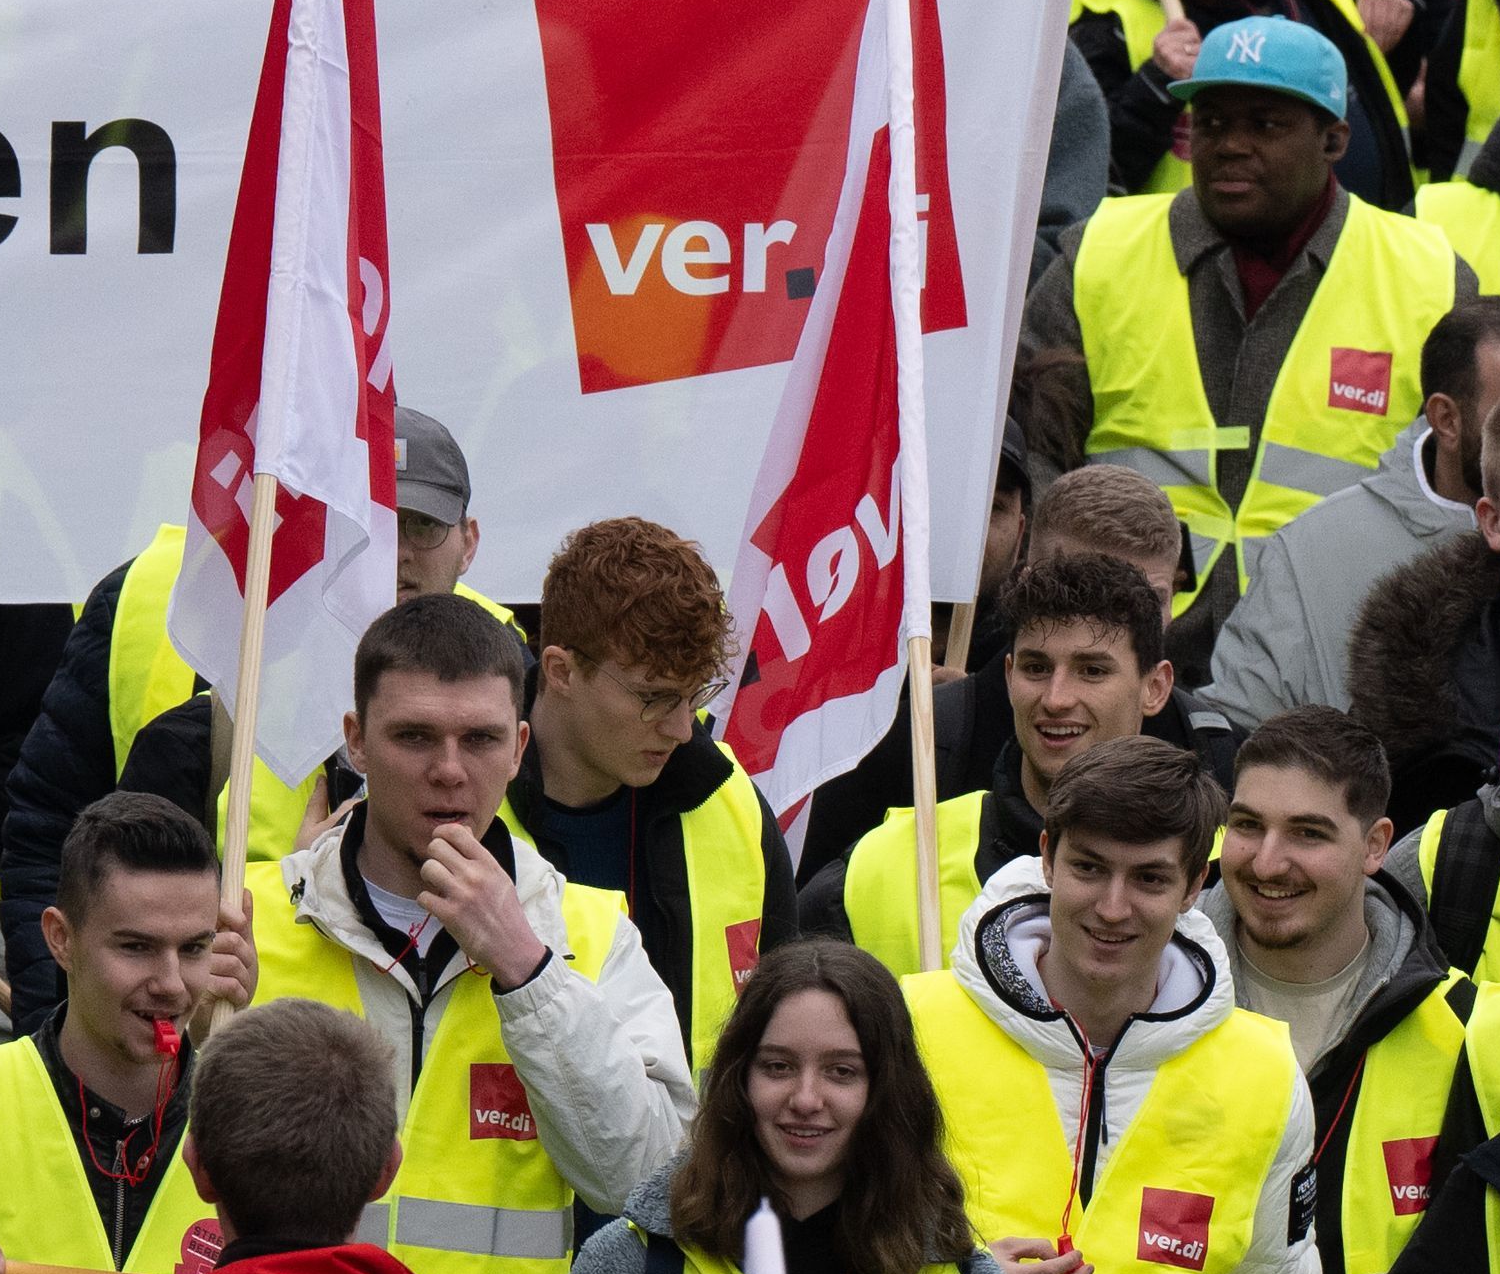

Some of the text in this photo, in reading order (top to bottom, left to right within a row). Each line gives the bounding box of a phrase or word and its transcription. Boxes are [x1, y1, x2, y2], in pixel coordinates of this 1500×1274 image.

[584, 195, 930, 299] ver.i
[1332, 381, 1385, 409] ver.di
[474, 1108, 531, 1133] ver.di
[193, 1226, 224, 1246] STRE
[1142, 1230, 1205, 1261] ver.di
[188, 1241, 220, 1260] BERE
